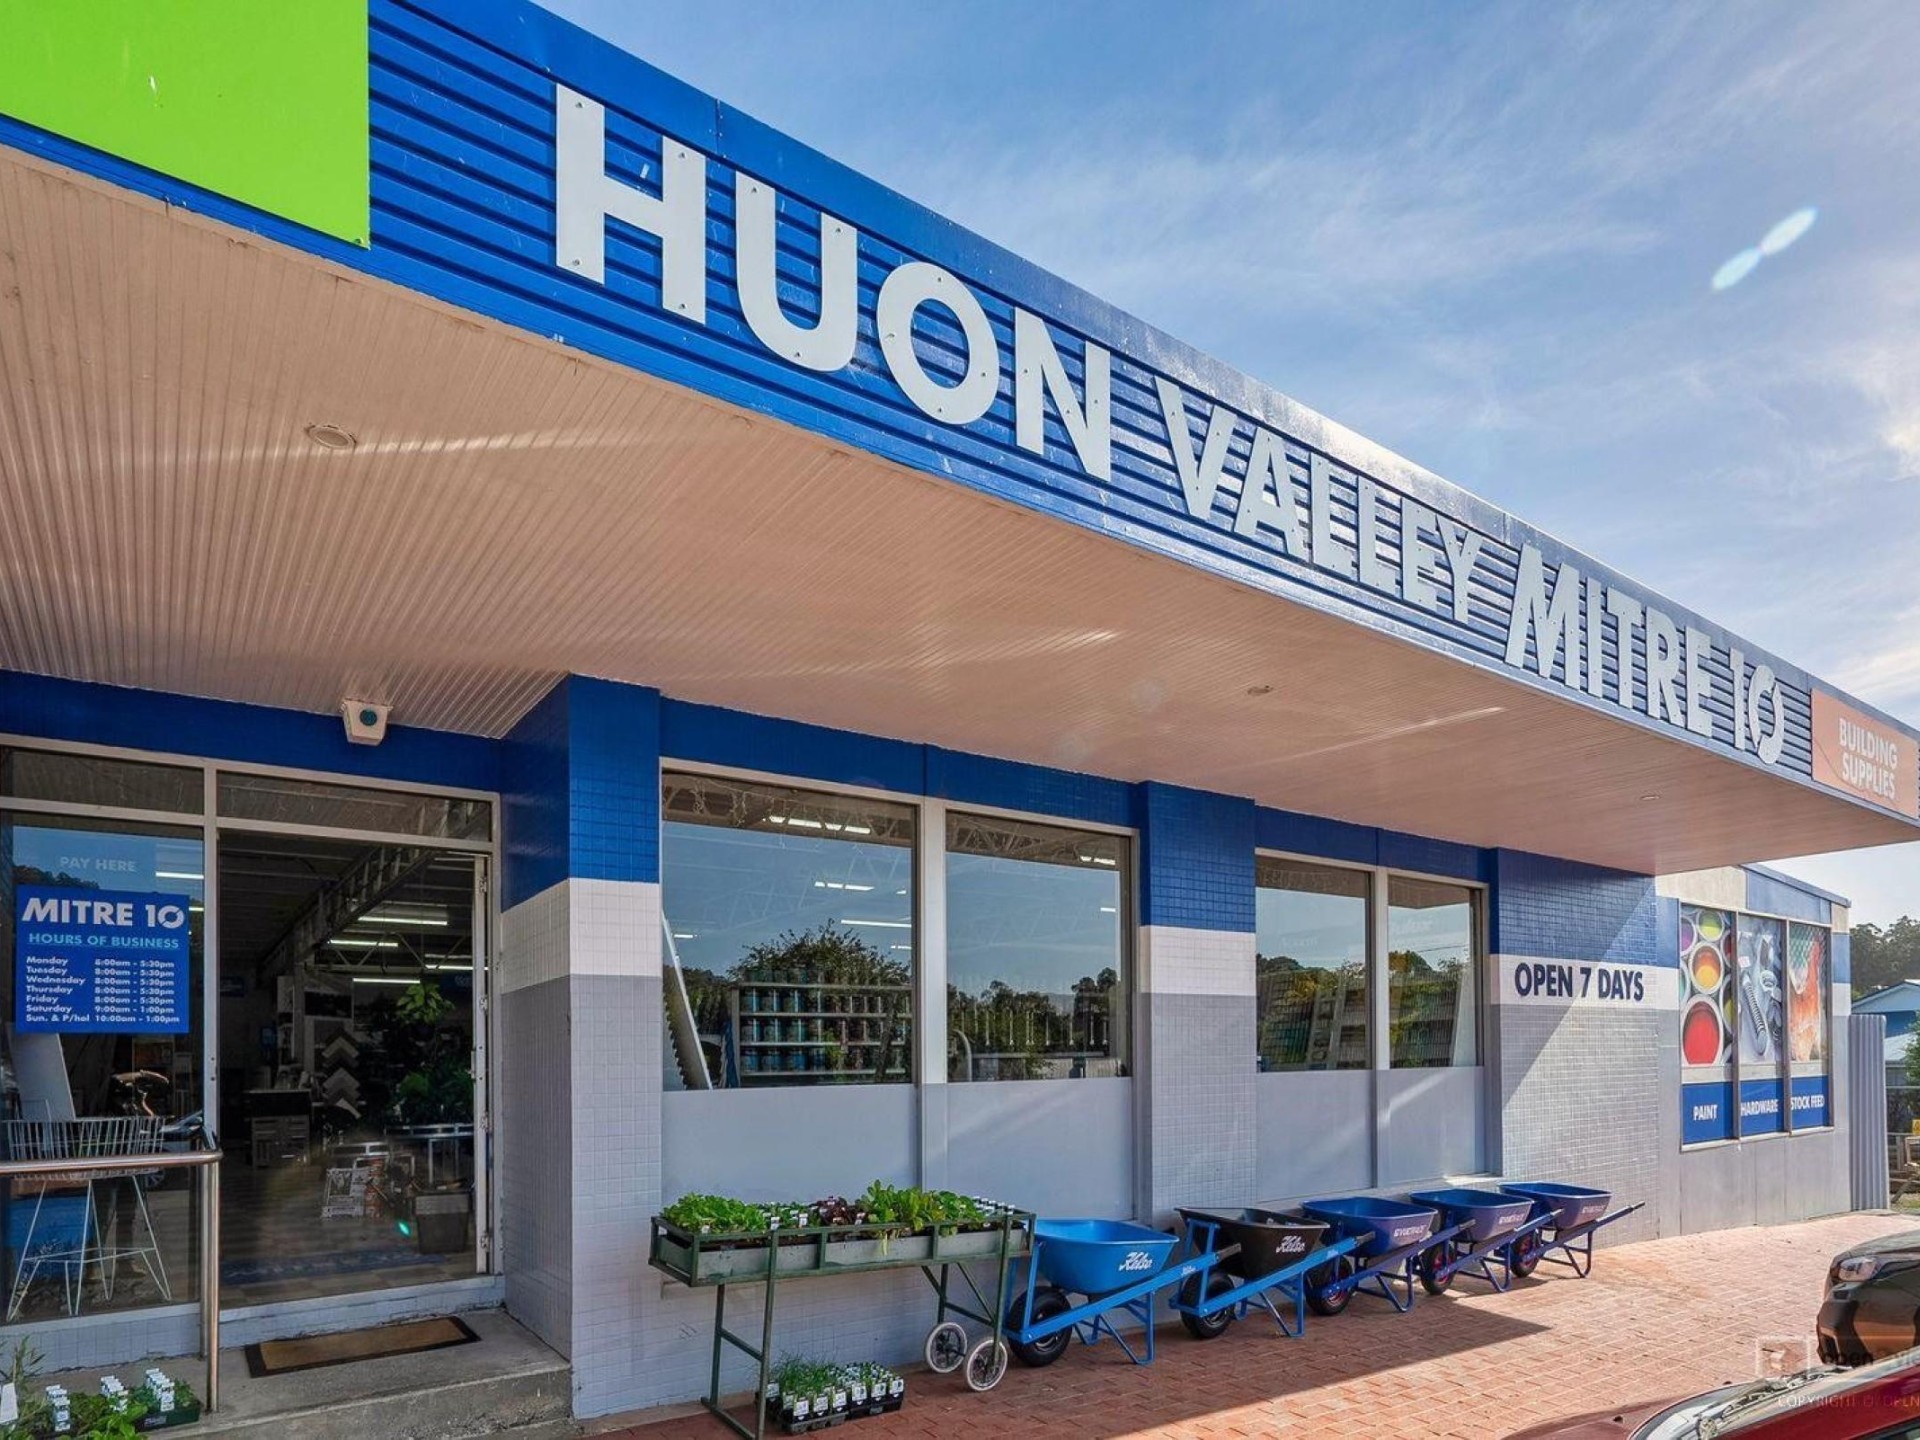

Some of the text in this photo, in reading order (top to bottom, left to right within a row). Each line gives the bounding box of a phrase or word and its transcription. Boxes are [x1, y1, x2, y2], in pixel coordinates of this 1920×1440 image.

[556, 83, 1786, 765] HUON VALLEY MITRE 10
[1839, 717, 1898, 771] BUILDING
[1842, 752, 1896, 800] SUPPLIES
[60, 856, 138, 873] PAY HERE
[22, 897, 185, 929] MITRE 10
[29, 933, 179, 949] HOURS OF BUSINESS
[26, 956, 68, 967] Monday
[26, 966, 68, 976] Tuesday
[26, 975, 86, 986] Wednesday
[1514, 962, 1644, 1001] OPEN 7 DAYS
[26, 985, 74, 995] Thursday
[26, 995, 59, 1004] Friday
[26, 1004, 72, 1013] Saturday
[1740, 1099, 1779, 1117] HARDWARE
[1790, 1094, 1826, 1111] STOCK FEED
[1693, 1104, 1718, 1121] PAINT
